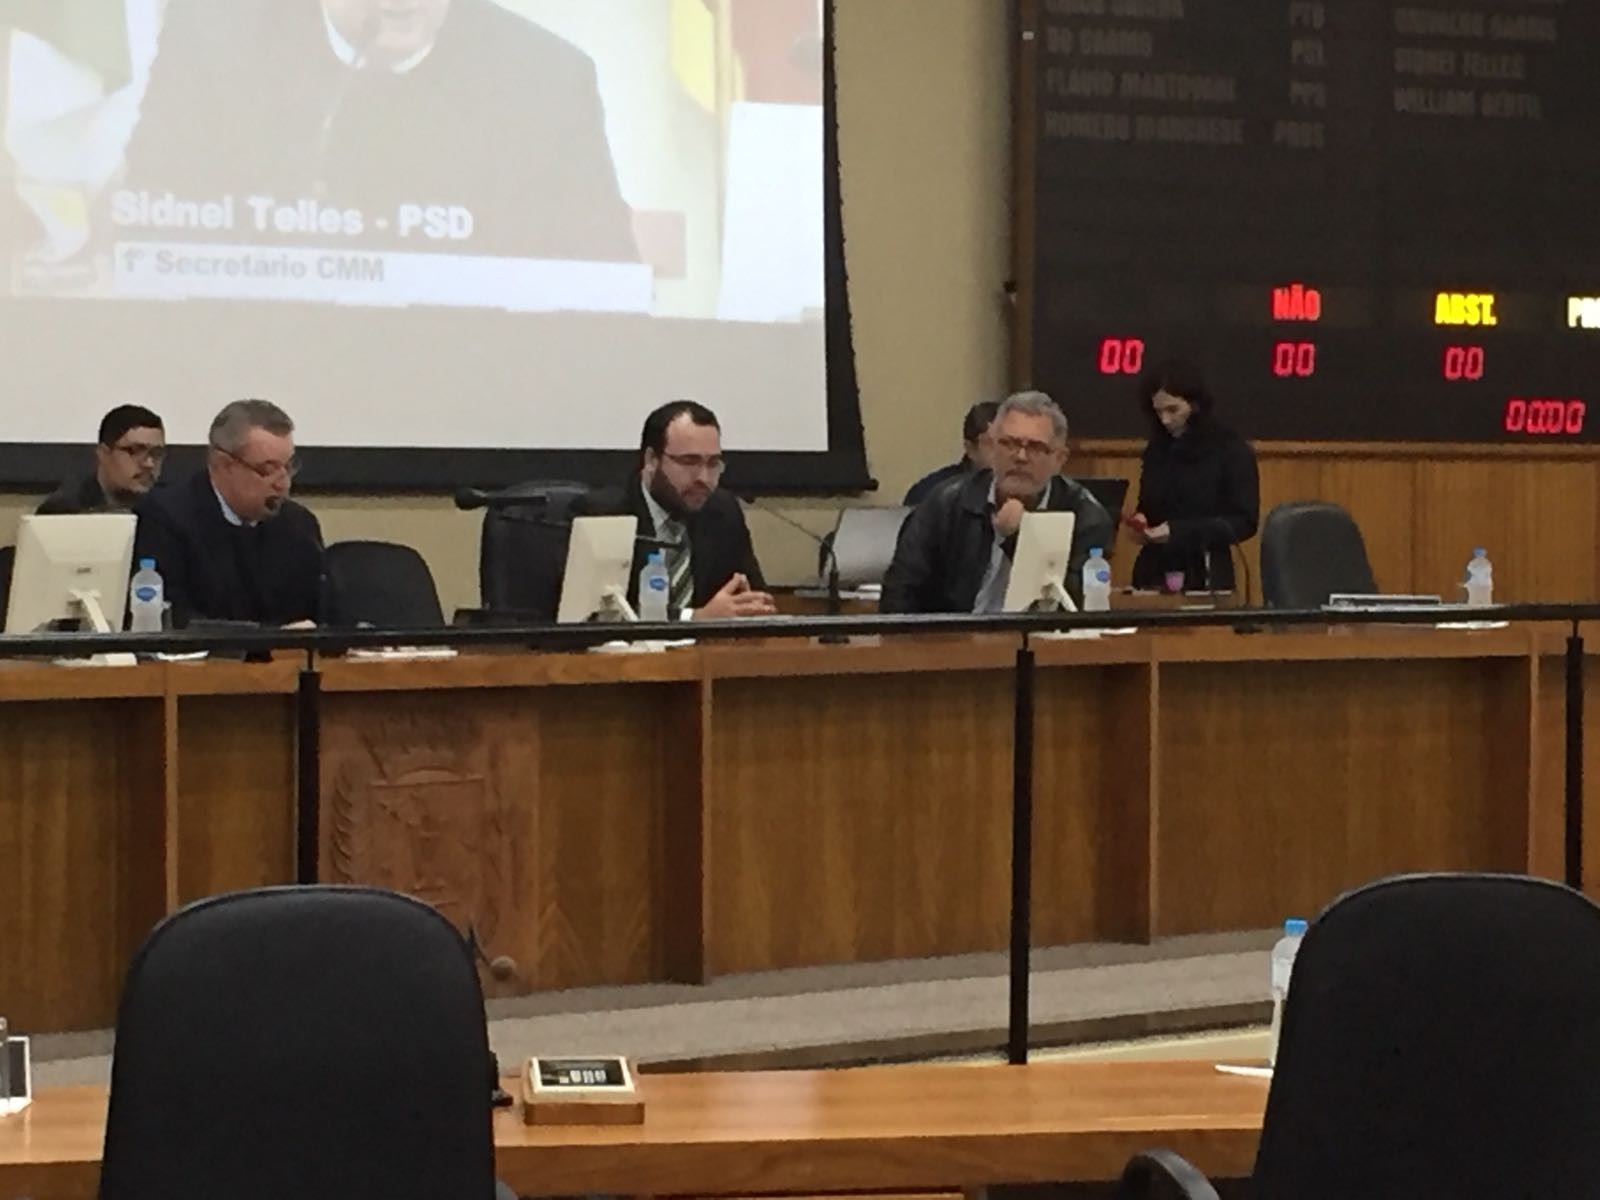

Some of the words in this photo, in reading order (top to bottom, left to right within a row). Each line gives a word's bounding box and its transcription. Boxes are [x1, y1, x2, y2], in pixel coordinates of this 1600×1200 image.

[112, 190, 233, 230] Sidnei
[247, 195, 363, 235] Telles
[398, 204, 474, 239] PSD
[317, 256, 385, 282] CMM
[1273, 284, 1321, 321] NÃO
[1435, 292, 1498, 326] ABST.
[1099, 338, 1144, 374] 00
[1273, 342, 1316, 377] 00
[1444, 346, 1484, 380] 00
